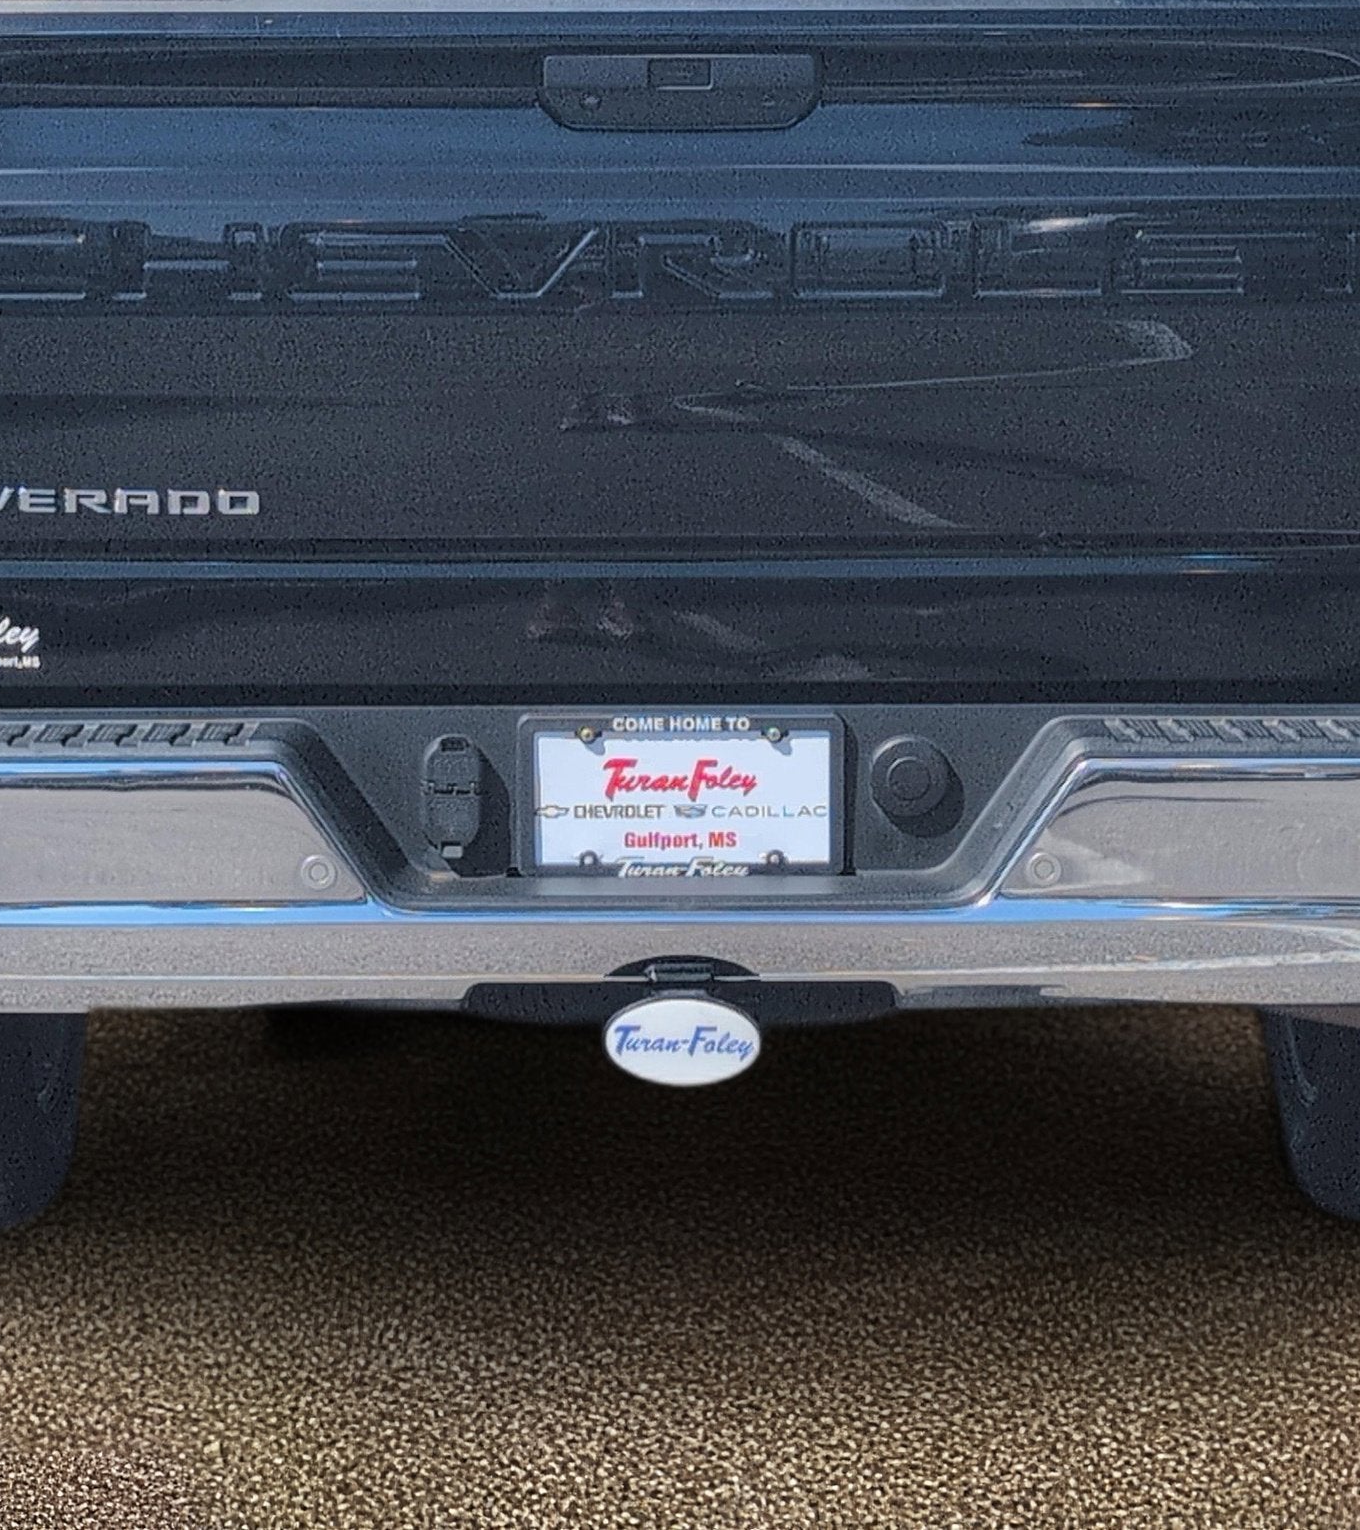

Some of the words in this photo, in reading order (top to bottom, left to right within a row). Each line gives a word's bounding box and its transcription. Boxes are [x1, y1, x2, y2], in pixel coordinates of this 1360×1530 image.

[612, 717, 664, 731] COME
[669, 717, 723, 731] HOME
[727, 717, 751, 731] TO
[573, 804, 665, 820] CHEVROLET
[711, 804, 828, 819] CADILLAC
[623, 831, 703, 850] Gulfport,
[708, 832, 738, 848] MS
[614, 1024, 754, 1062] Turan-Foley
